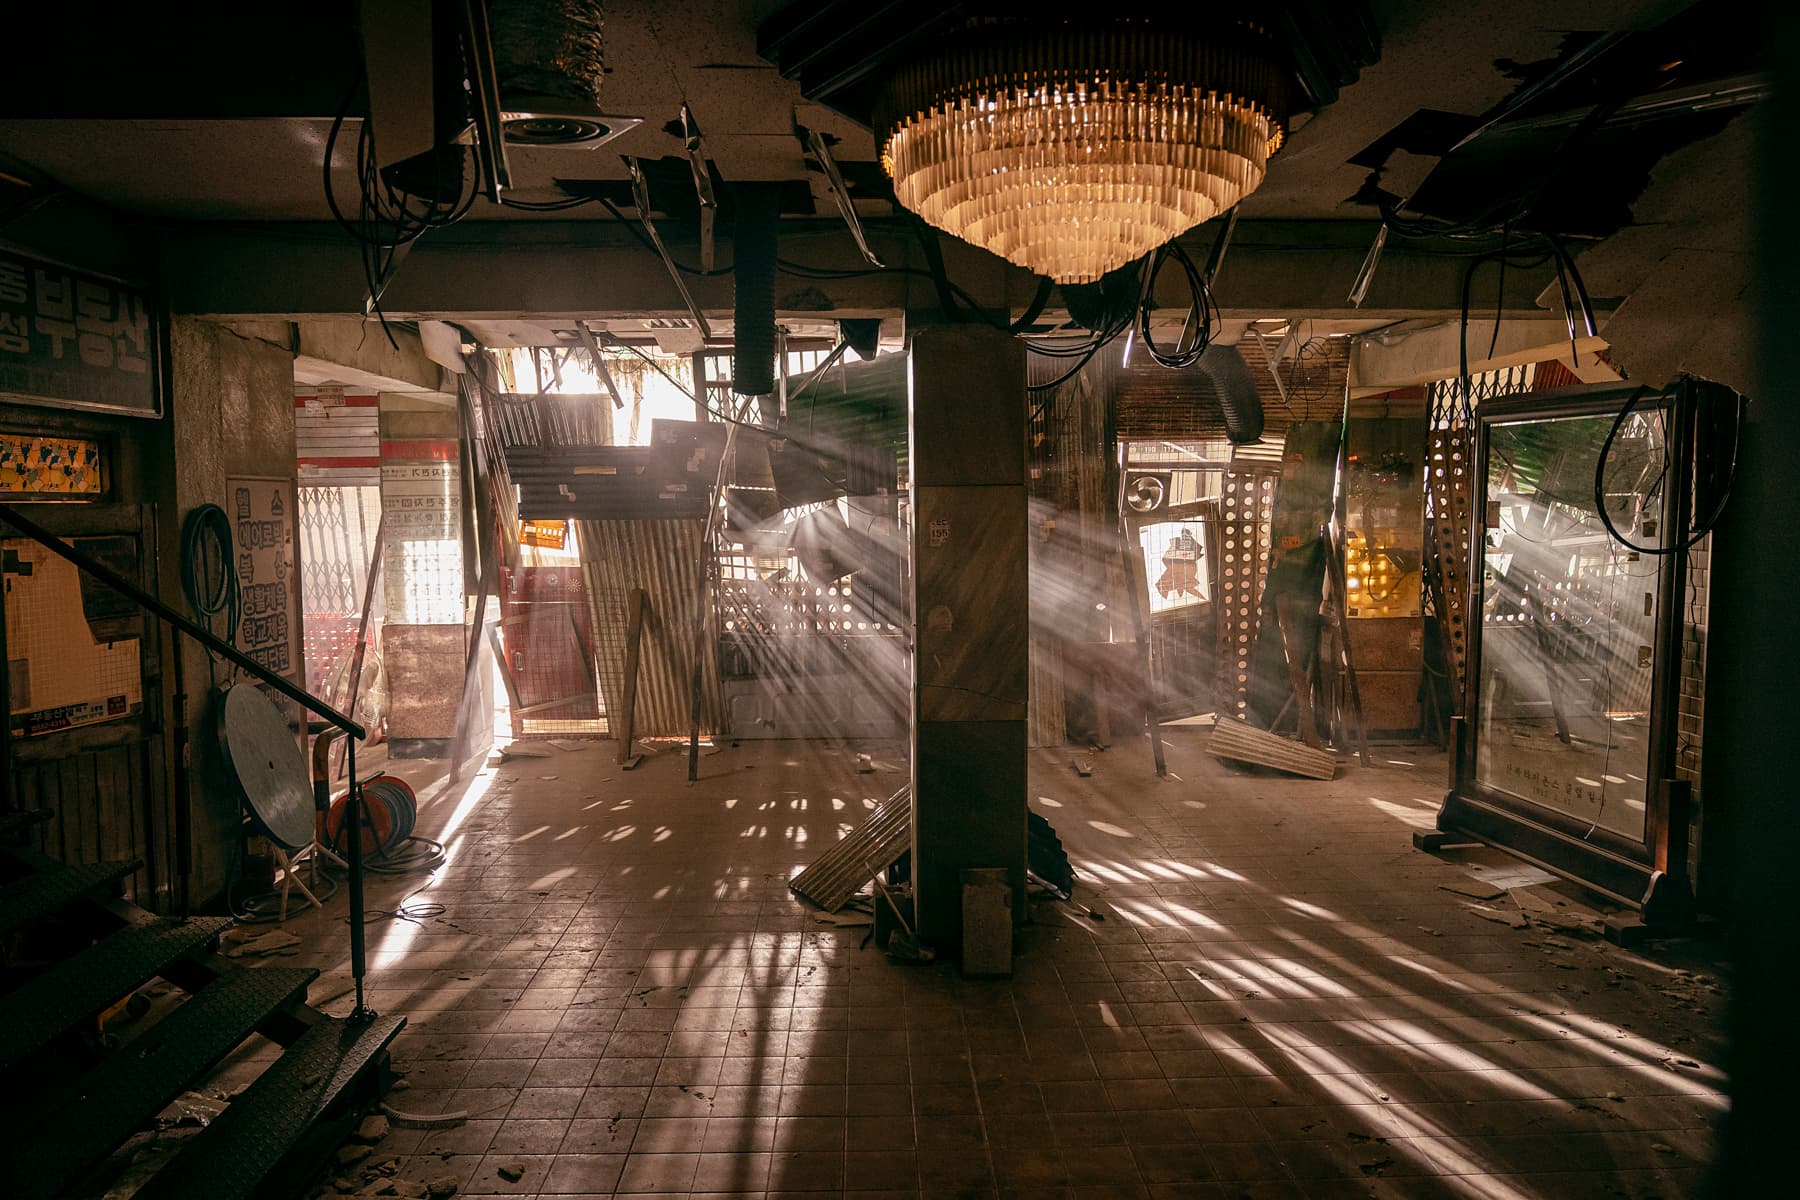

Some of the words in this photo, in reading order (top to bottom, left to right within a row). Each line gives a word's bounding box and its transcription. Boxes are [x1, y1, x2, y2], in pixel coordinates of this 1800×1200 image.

[34, 270, 150, 374] 부동산
[238, 519, 285, 549] 에어로빅
[243, 581, 287, 617] 생활체육
[243, 611, 288, 647] 학교체육
